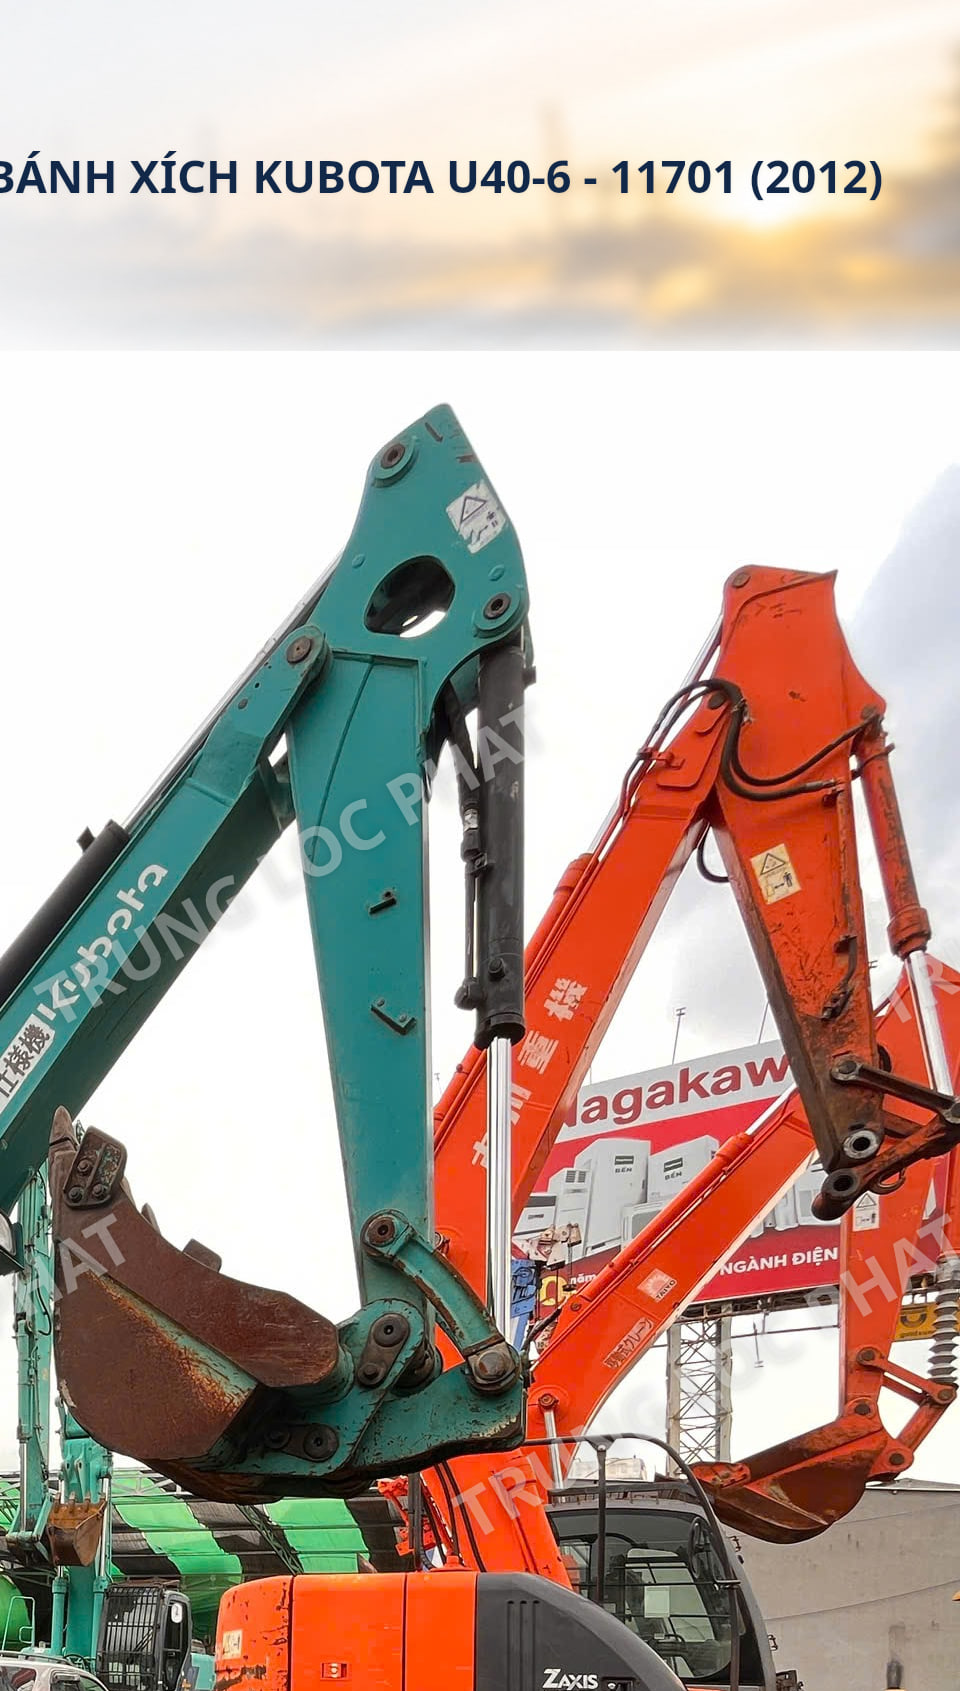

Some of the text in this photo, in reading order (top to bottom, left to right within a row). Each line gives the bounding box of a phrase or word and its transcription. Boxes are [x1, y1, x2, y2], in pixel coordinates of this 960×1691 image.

[37, 864, 168, 1021] Kubota
[561, 1053, 790, 1128] agakaw
[720, 1246, 838, 1276] NGÀNH ĐIỆN
[542, 1668, 598, 1690] ZAXIS
